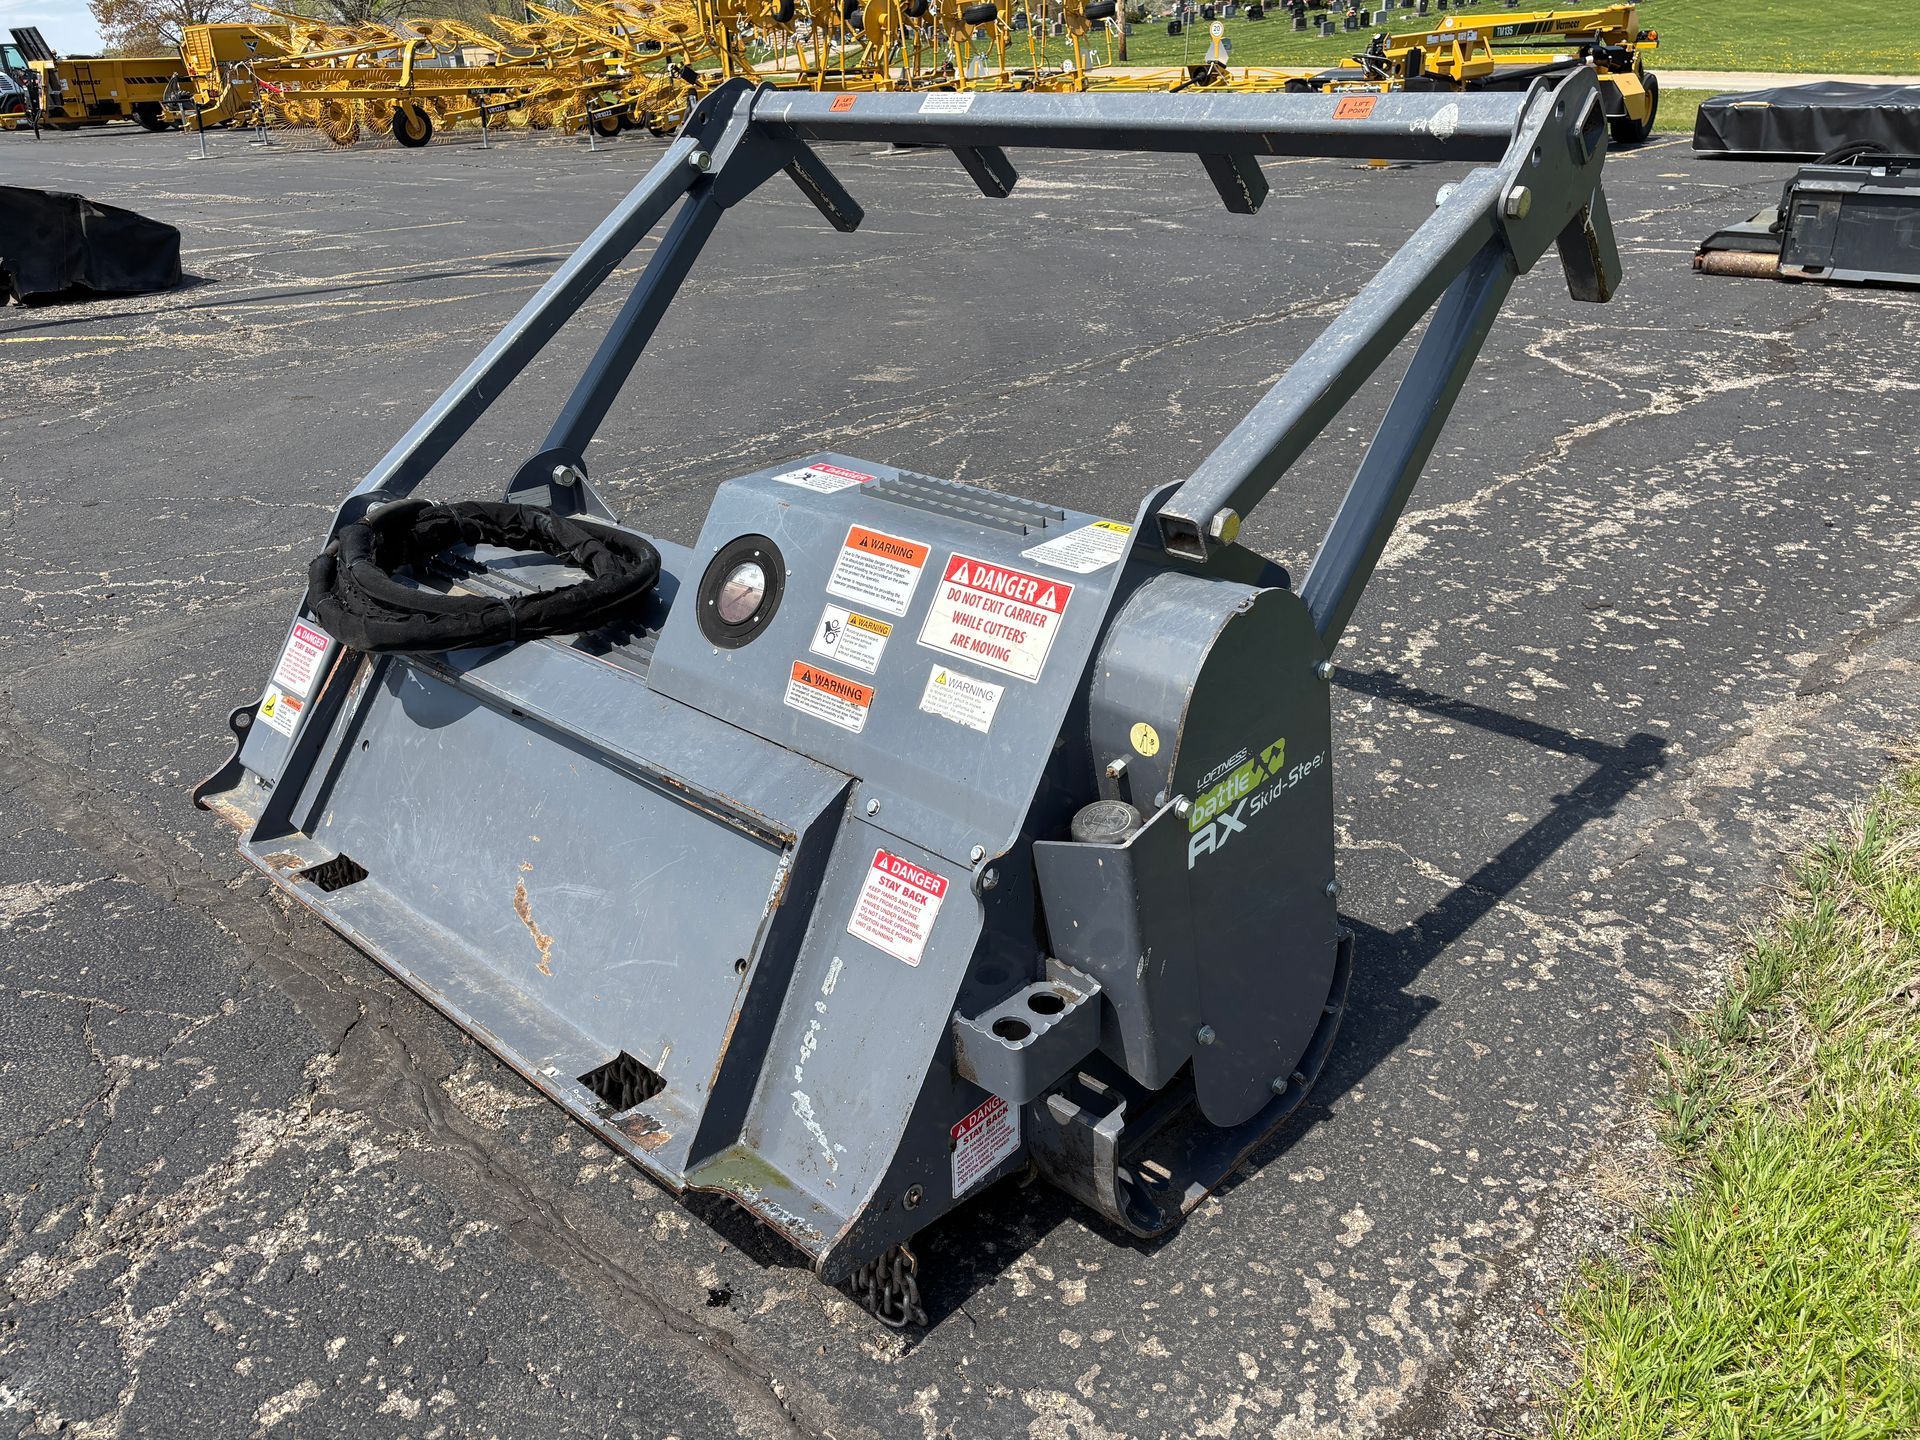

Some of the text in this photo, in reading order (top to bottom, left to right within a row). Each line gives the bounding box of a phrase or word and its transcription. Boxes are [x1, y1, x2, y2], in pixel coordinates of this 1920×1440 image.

[1556, 20, 1580, 30] Vermeer
[826, 467, 867, 480] DANGER
[870, 539, 914, 559] WARNING
[971, 566, 1041, 603] DANGER
[947, 588, 1048, 628] DO NOT EXIT CARRIER
[301, 630, 325, 649] DANGER
[858, 619, 889, 634] WARNING
[951, 611, 1027, 645] WHILE CUTTERS
[294, 641, 317, 658] STAY BACK
[950, 632, 1012, 662] ARE MOVING
[813, 674, 864, 701] WARNING
[1197, 747, 1248, 789] LOFTNESS
[1189, 798, 1247, 870] AX
[1250, 751, 1326, 817] Skid-Steer
[1192, 771, 1249, 827] battle
[878, 876, 929, 906] STAY BACK
[891, 861, 941, 894] DANGER
[863, 899, 880, 911] KNIVES
[880, 907, 897, 919] UNDER
[866, 892, 917, 921] AWAY FROM ROTATING
[868, 885, 921, 914] KEEP HANDS AND FEET
[855, 920, 866, 929] UNIT
[858, 913, 913, 944] POSITION WHILE POWER
[868, 909, 878, 918] NOT
[878, 915, 893, 926] LEAVE
[893, 922, 922, 940] OPERATORS
[964, 1105, 1008, 1146] STAY BACK
[969, 1097, 1003, 1127] DANG
